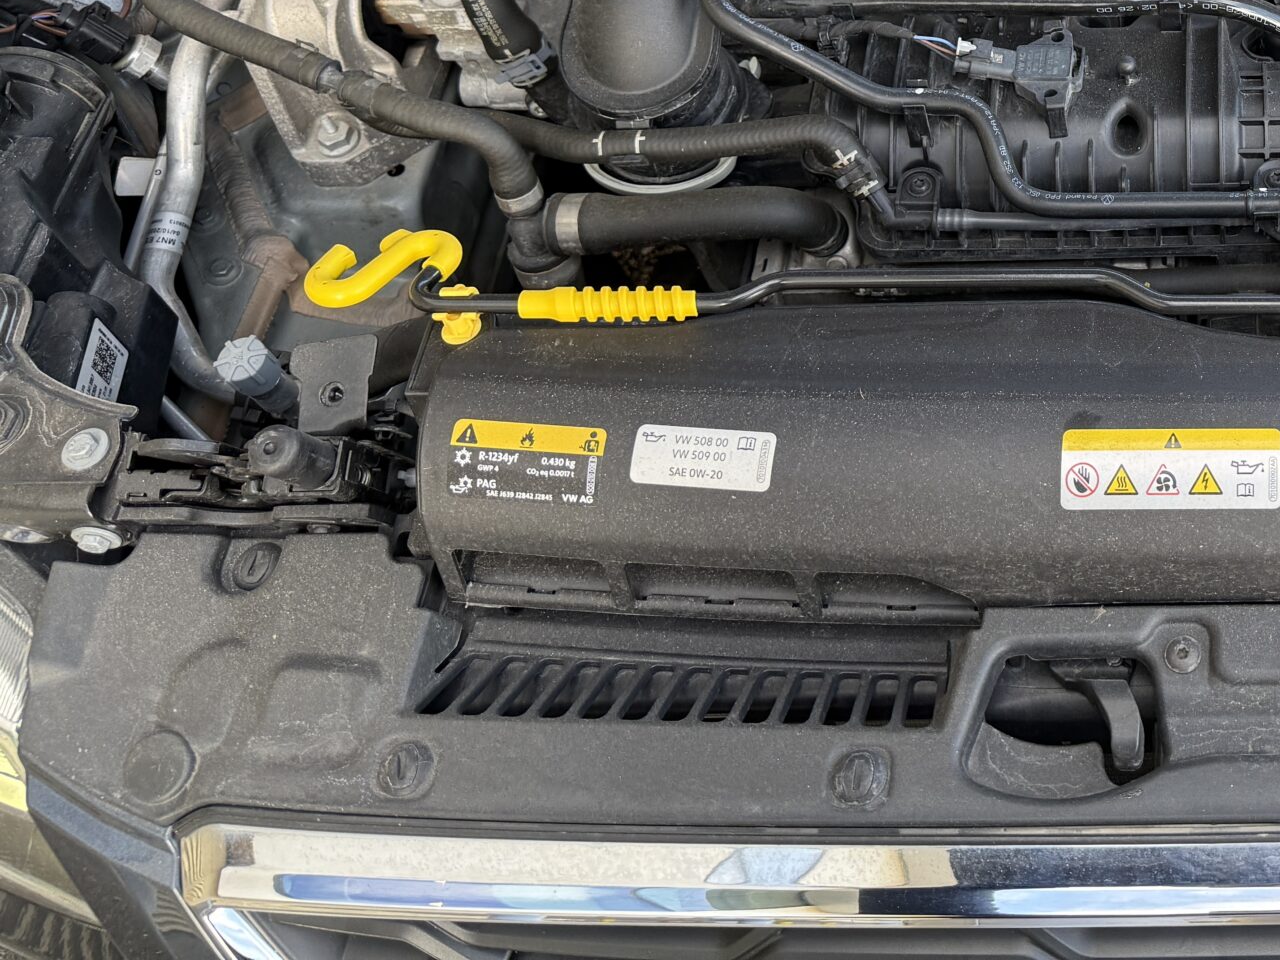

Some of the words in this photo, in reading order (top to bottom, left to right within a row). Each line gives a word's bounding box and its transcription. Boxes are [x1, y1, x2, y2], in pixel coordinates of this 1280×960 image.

[1065, 193, 1098, 201] Poland
[675, 434, 691, 444] VW
[694, 436, 713, 446] 508
[715, 437, 729, 448] 00
[478, 451, 519, 465] R-1234yf
[672, 449, 689, 459] VW
[691, 450, 710, 461] 509
[713, 451, 726, 462] 00
[541, 457, 564, 466] 0.430
[565, 458, 576, 469] kg
[549, 470, 570, 478] 0.0017
[668, 466, 687, 478] SAE
[689, 468, 723, 480] 0W-20
[476, 479, 497, 489] PAG
[561, 493, 578, 503] VW
[579, 495, 594, 504] AG
